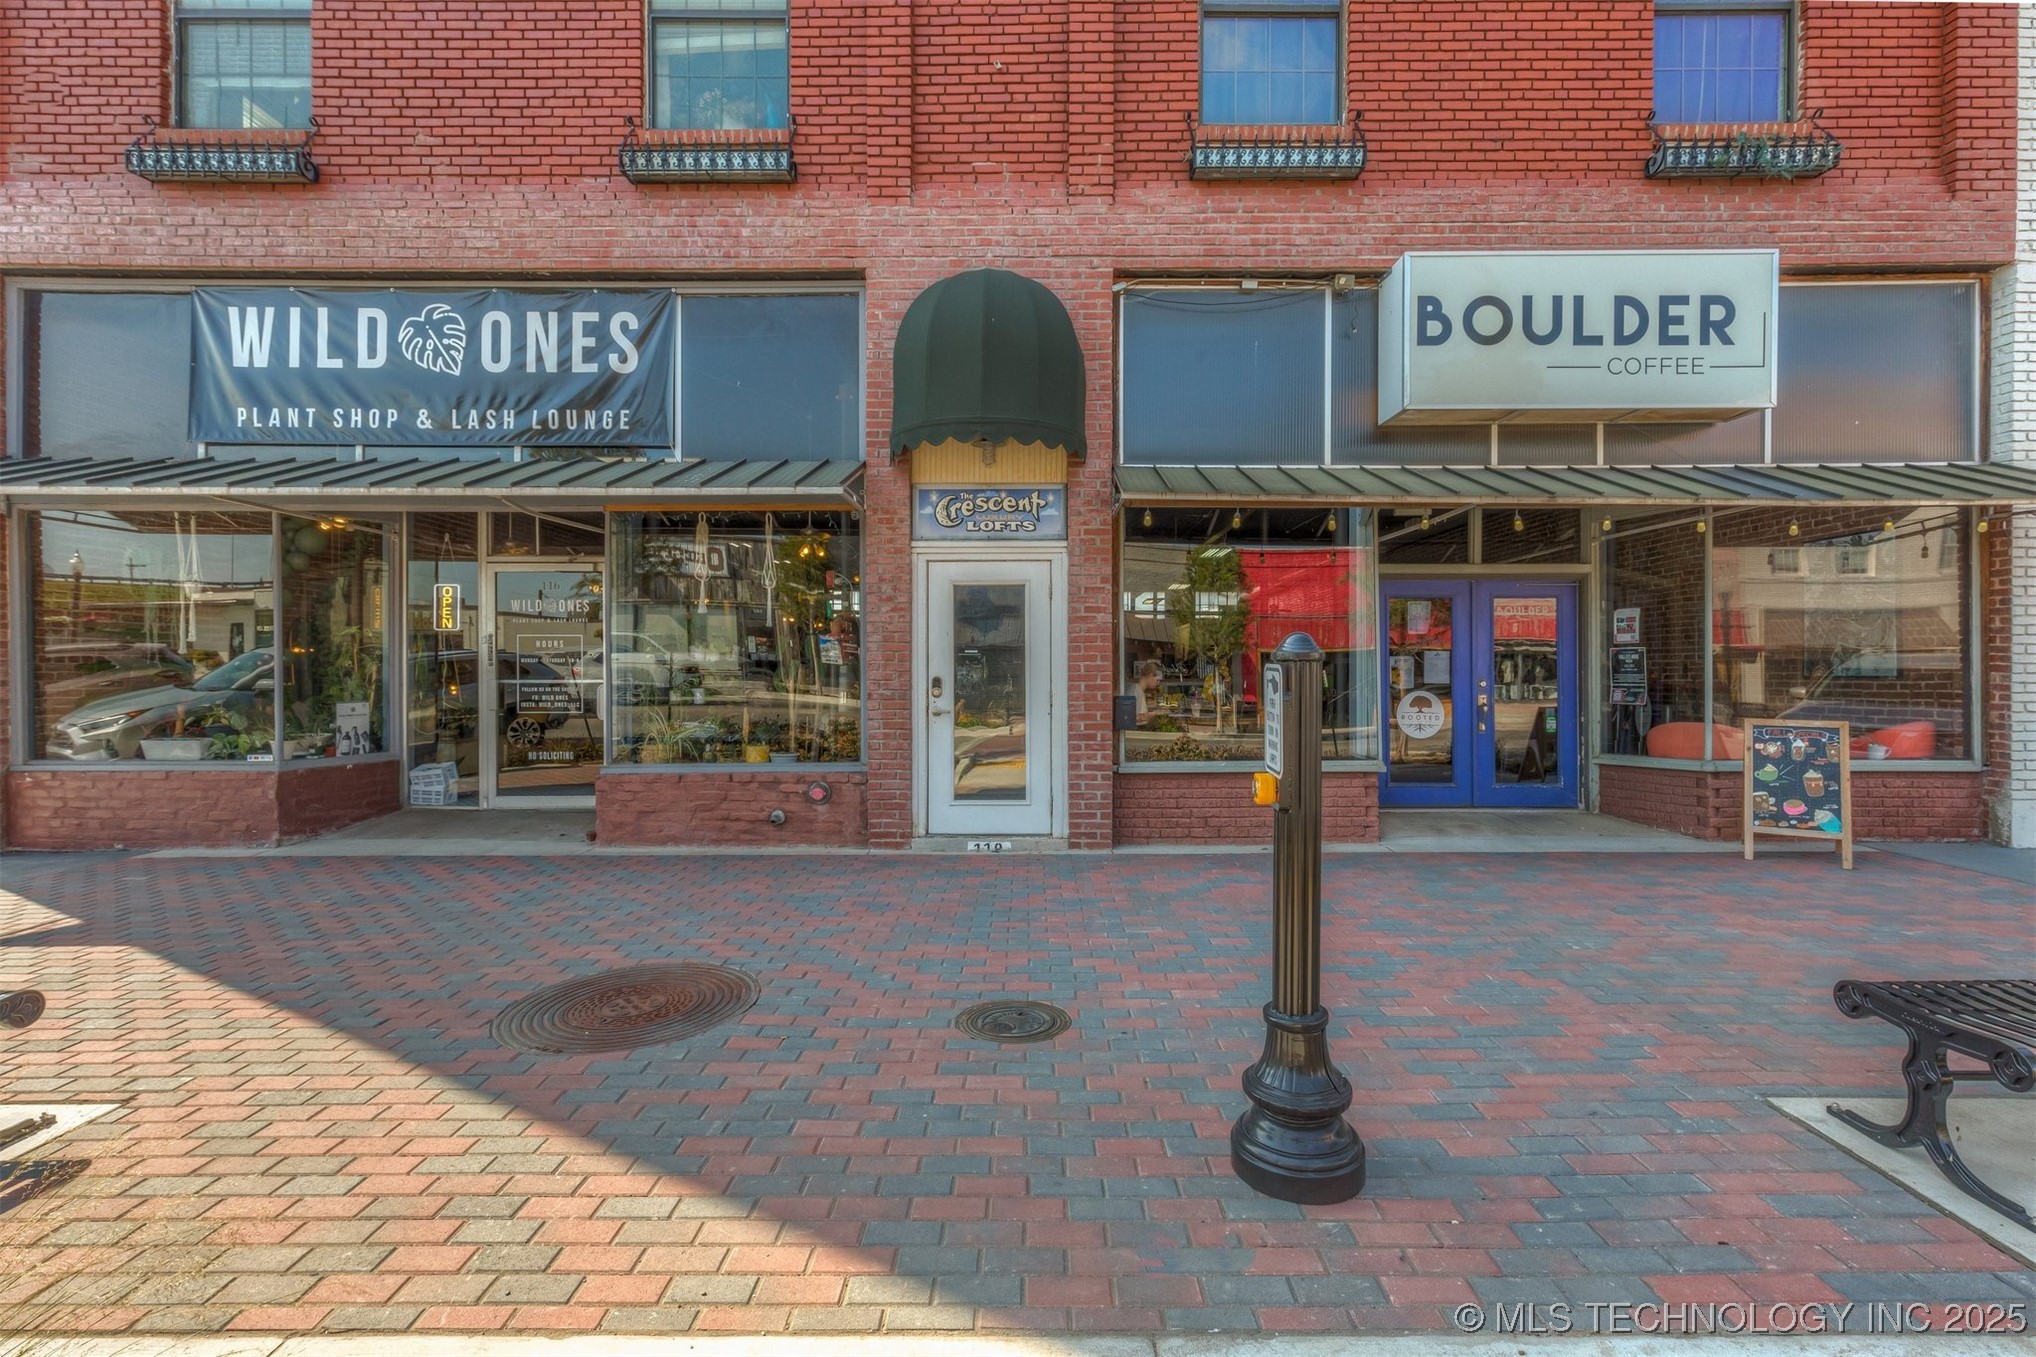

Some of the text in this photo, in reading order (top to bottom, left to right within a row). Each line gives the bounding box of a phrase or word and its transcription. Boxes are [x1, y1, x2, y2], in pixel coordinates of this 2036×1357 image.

[1416, 295, 1737, 347] BOULDER
[227, 305, 640, 375] WILD ONES
[1606, 356, 1706, 376] COFFEE
[236, 407, 632, 431] PLANT SHOP & LASH LOUNGE
[959, 492, 974, 501] The
[934, 490, 1048, 528] Crescent
[975, 514, 1025, 522] LUXURY
[965, 521, 1036, 532] LOFTS
[542, 581, 561, 591] 116
[442, 586, 453, 629] OPEN
[511, 599, 590, 613] WILD ONES
[535, 640, 564, 648] HOURS
[527, 751, 575, 760] NO SOLICITING
